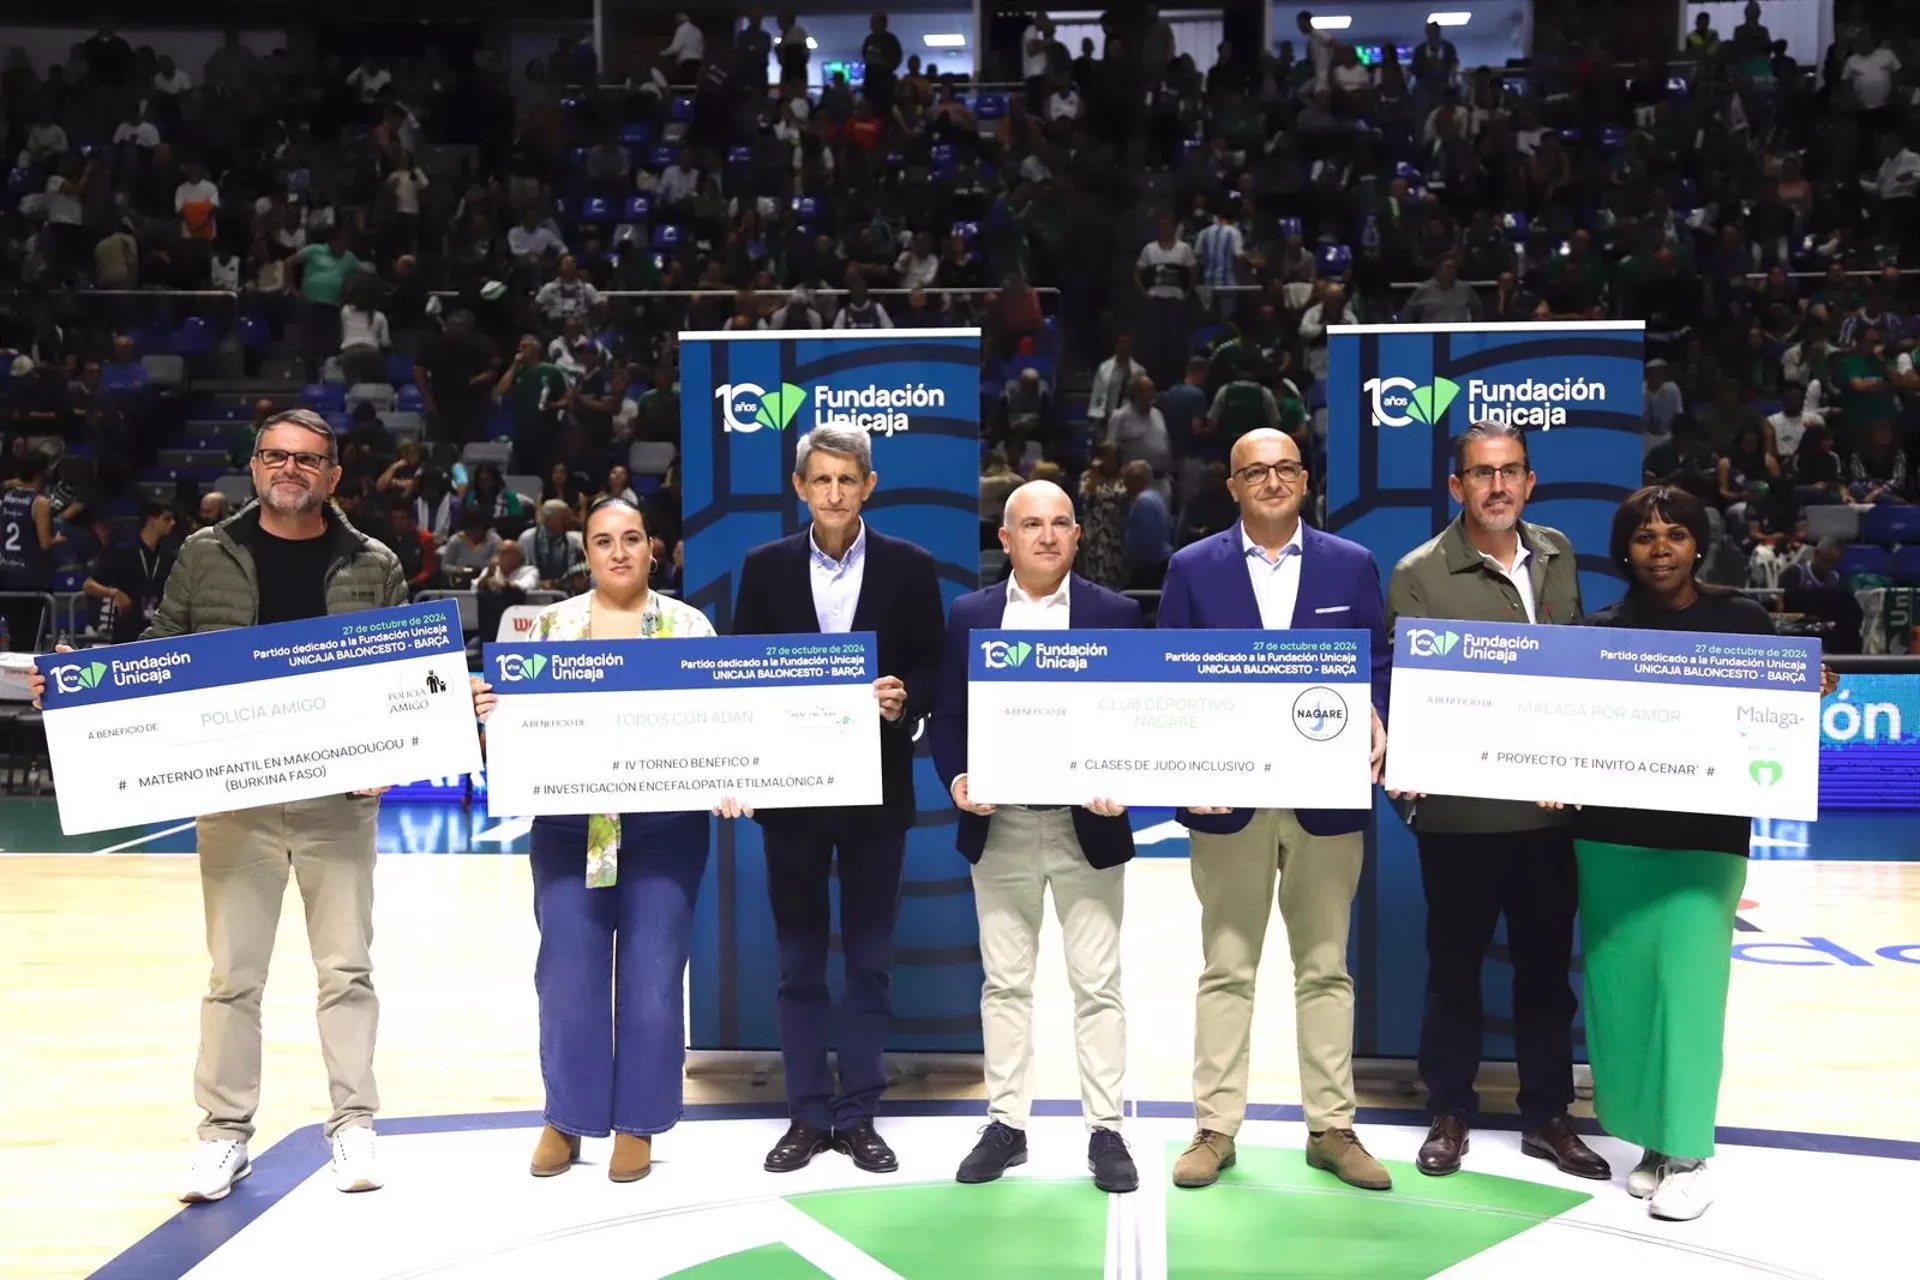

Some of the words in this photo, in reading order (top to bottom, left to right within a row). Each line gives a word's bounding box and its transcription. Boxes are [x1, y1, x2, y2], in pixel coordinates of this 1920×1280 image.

[815, 383, 944, 408] Fundación
[1469, 378, 1605, 402] Fundación
[734, 402, 757, 412] años
[1384, 396, 1408, 407] años
[1469, 403, 1566, 431] Unicaja
[4, 521, 22, 551] 2
[342, 625, 354, 636] 27
[355, 625, 368, 634] de
[369, 620, 408, 632] octubre
[409, 617, 422, 626] de
[423, 612, 447, 624] 2024
[253, 647, 291, 659] Partido
[292, 640, 339, 654] dedicado
[340, 639, 347, 648] a
[347, 637, 358, 646] la
[358, 630, 410, 645] Fundación
[411, 624, 448, 637] Unicaja
[766, 646, 777, 656] 27
[778, 647, 790, 655] de
[791, 646, 828, 655] octubre
[829, 645, 841, 654] de
[843, 644, 865, 654] 2024
[1036, 643, 1108, 656] Fundación
[1253, 641, 1265, 651] 27
[1266, 642, 1279, 651] de
[1280, 642, 1318, 651] octubre
[1319, 642, 1332, 651] de
[1334, 641, 1357, 651] 2024
[1464, 633, 1539, 650] Fundación
[289, 652, 335, 667] UNICAJA
[336, 641, 406, 660] BALONCESTO
[414, 635, 450, 649] BARÇA
[1165, 652, 1201, 662] Partido
[1202, 653, 1248, 662] dedicado
[1248, 654, 1256, 662] a
[1257, 652, 1267, 662] la
[1267, 652, 1319, 662] Fundación
[1319, 653, 1357, 664] Unicaja
[1463, 646, 1518, 664] Unicaja
[1695, 644, 1707, 653] 27
[1709, 645, 1722, 654] de
[1723, 647, 1765, 657] octubre
[1766, 649, 1780, 657] de
[1782, 649, 1807, 658] 2024
[112, 652, 191, 673] Fundación
[552, 653, 624, 667] Fundación
[681, 659, 716, 669] Partido
[717, 658, 761, 669] dedicado
[762, 659, 769, 667] a
[769, 657, 779, 667] la
[780, 656, 829, 666] Fundación
[829, 655, 865, 665] Unicaja
[1036, 655, 1088, 672] Unicaja
[1600, 649, 1639, 661] Partido
[1640, 652, 1688, 664] dedicado
[1689, 656, 1697, 664] a
[1698, 655, 1709, 665] la
[1709, 656, 1765, 668] Fundación
[1766, 659, 1807, 671] Unicaja
[114, 667, 172, 686] Unicaja
[552, 666, 604, 682] Unicaja
[713, 669, 756, 680] UNICAJA
[757, 667, 824, 679] BALONCESTO
[831, 666, 865, 678] BARÇA
[1197, 664, 1242, 674] UNICAJA
[1243, 664, 1313, 674] BALONCESTO
[1321, 663, 1357, 676] BARÇA
[1634, 663, 1682, 675] UNICAJA
[1683, 666, 1758, 680] BALONCESTO
[1767, 671, 1806, 684] BARÇA
[271, 697, 326, 717] AMIGO
[389, 700, 430, 714] AMIGO
[1098, 696, 1142, 712] CLUB
[1144, 695, 1235, 712] DEPORTIVO
[615, 712, 669, 727] TODOS
[672, 711, 708, 725] CON
[1297, 708, 1343, 720] NAGARE
[1591, 704, 1627, 720] POR
[1630, 708, 1681, 723] AMOR
[88, 731, 95, 740] A
[96, 725, 145, 739] BENEFICIO
[145, 722, 158, 732] DE
[119, 780, 127, 791] #
[139, 768, 204, 787] MATERNO
[205, 761, 262, 778] INFANTIL
[263, 757, 282, 769] EN
[283, 739, 404, 766] MAKOGNADOUGOU
[412, 736, 419, 747] #
[612, 760, 620, 771] #
[625, 760, 637, 771] IV
[639, 758, 689, 770] TORNEO
[752, 756, 760, 766] #
[1070, 761, 1078, 770] #
[1084, 759, 1133, 771] CLASES
[1134, 760, 1150, 771] DE
[1153, 760, 1187, 771] JUDO
[1188, 760, 1255, 772] INCLUSIVO
[1264, 763, 1272, 772] #
[1481, 751, 1489, 761] #
[1497, 752, 1567, 767] PROYECTO
[1591, 759, 1636, 772] INVITO
[1637, 761, 1647, 772] A
[1706, 766, 1715, 777] #
[225, 773, 288, 792] (BURKINA
[289, 764, 327, 781] FASO)
[533, 785, 541, 795] #
[827, 775, 835, 785] #
